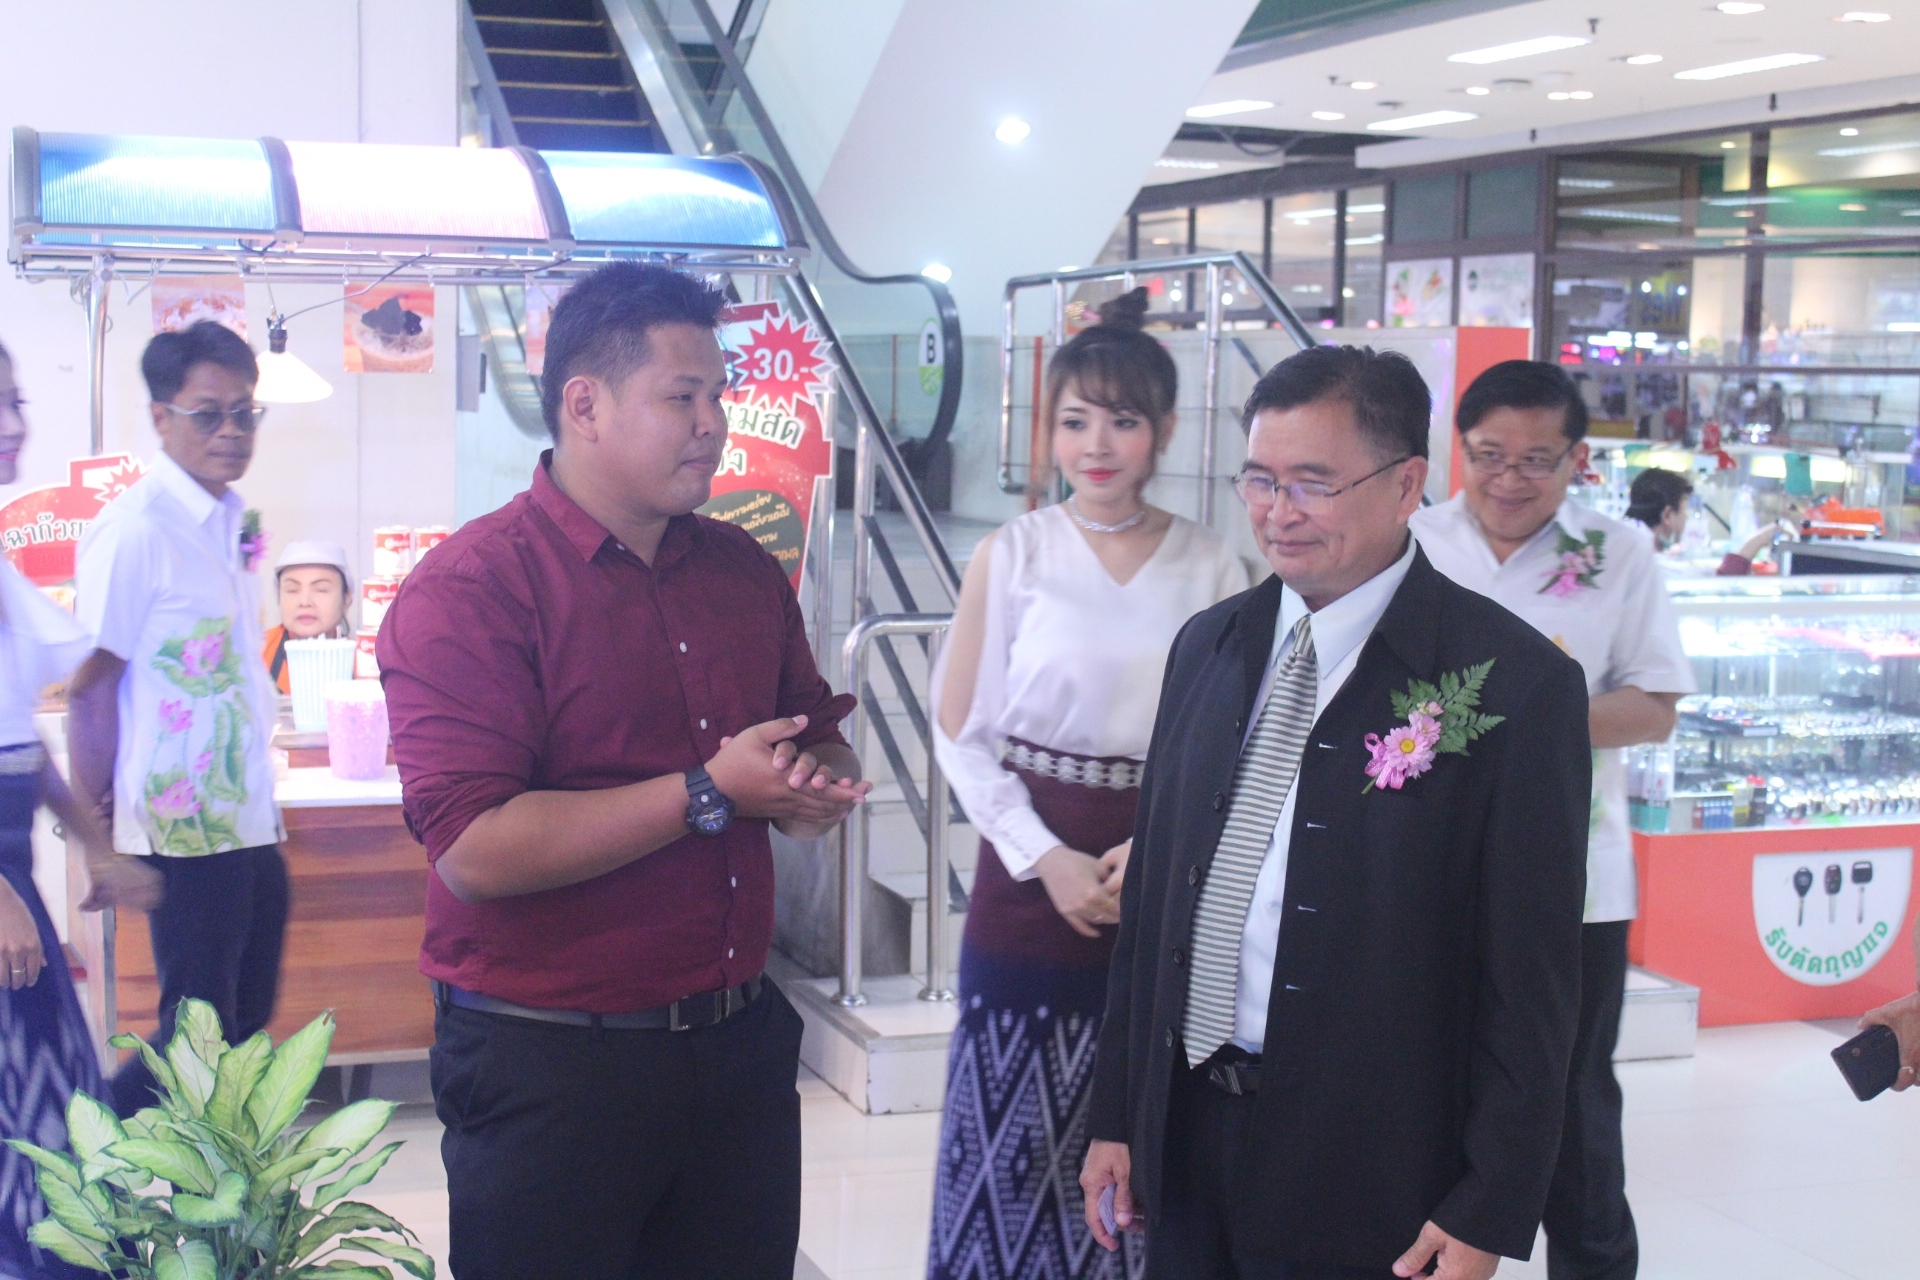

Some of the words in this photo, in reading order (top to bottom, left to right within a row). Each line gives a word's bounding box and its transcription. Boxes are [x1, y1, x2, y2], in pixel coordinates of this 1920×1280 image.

[752, 349, 810, 382] 30.-
[1764, 921, 1889, 978] รับตัดกุญแจ
